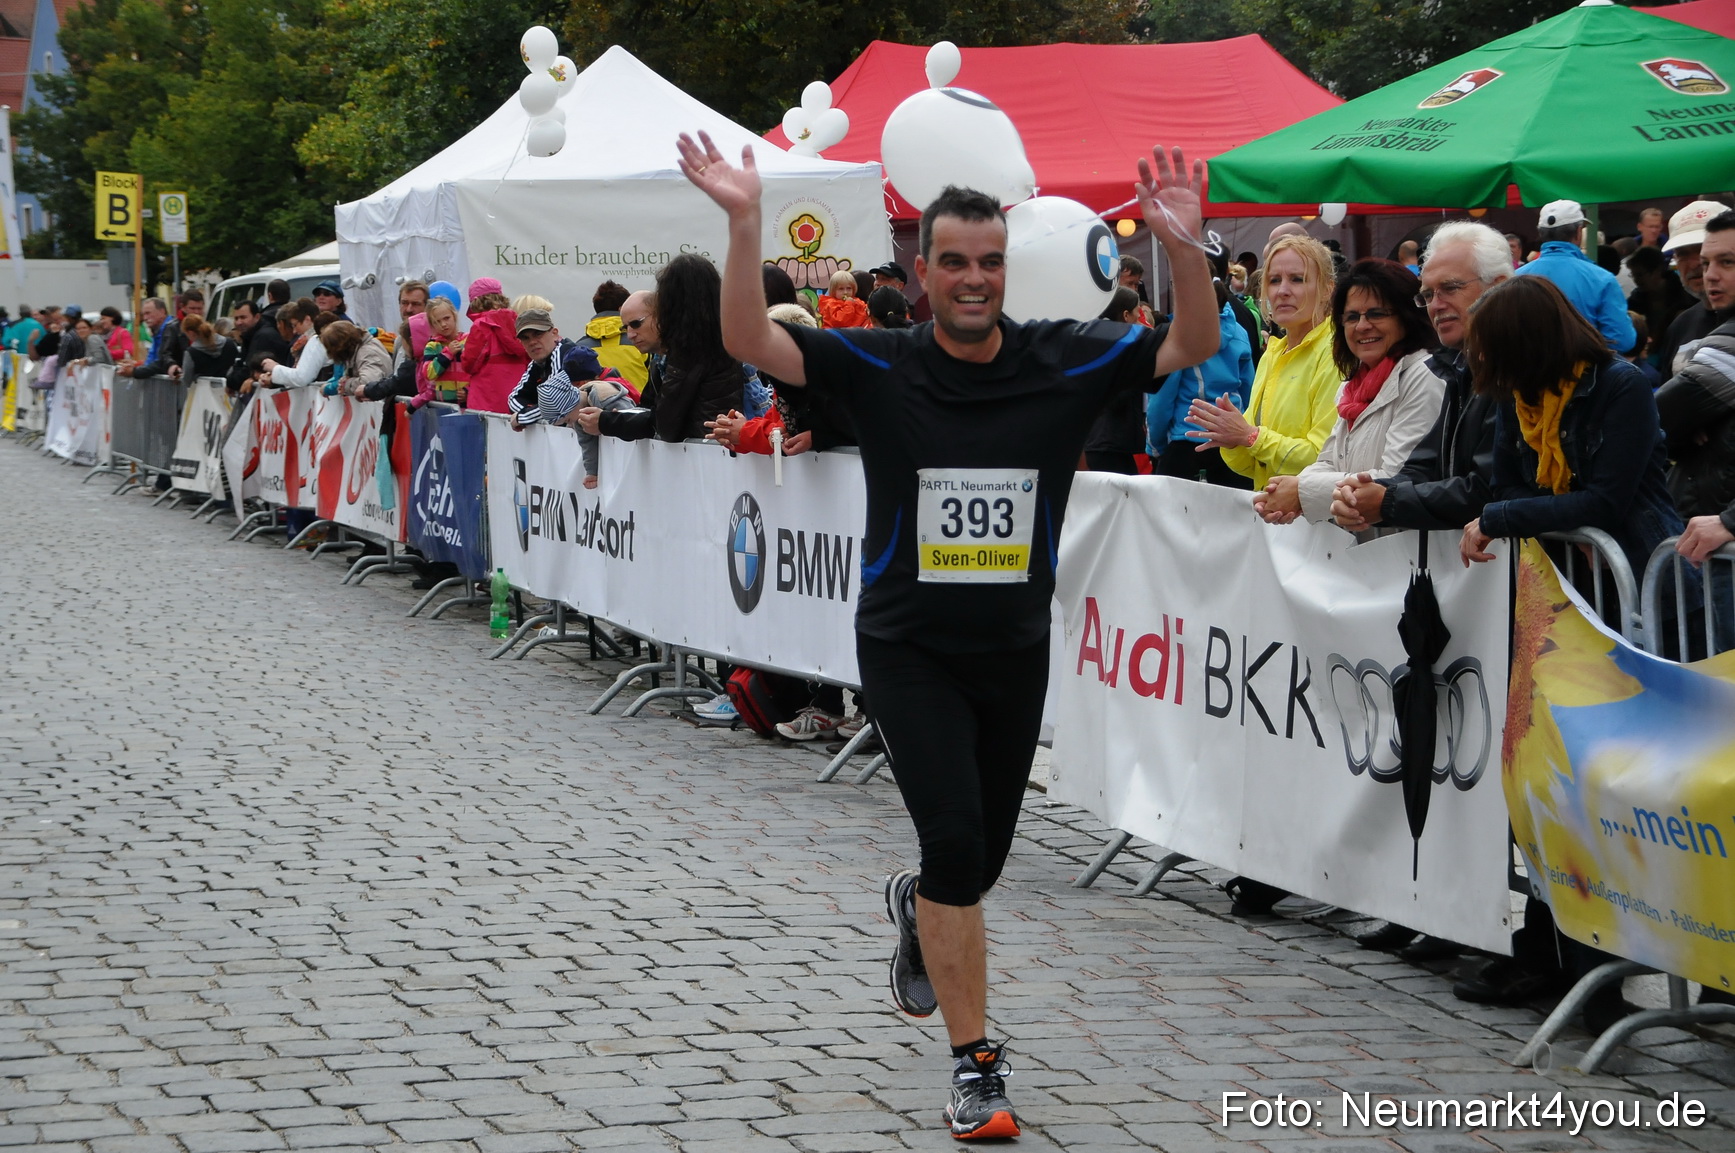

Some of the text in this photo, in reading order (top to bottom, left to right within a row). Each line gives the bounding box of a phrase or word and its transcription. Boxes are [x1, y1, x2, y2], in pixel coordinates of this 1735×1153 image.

[1356, 116, 1457, 133] Neumarkter
[1310, 131, 1448, 152] Lammsbräu
[102, 174, 138, 189] Block
[109, 193, 130, 226] B
[775, 201, 793, 223] KRANKEN
[793, 196, 806, 204] UND
[806, 196, 833, 214] EINSAMEN
[830, 213, 841, 238] KINDERN
[495, 245, 568, 266] Kinder
[574, 244, 671, 266] brauchen
[920, 480, 1018, 491] PARTL Neumarkt
[940, 497, 1014, 539] 393
[777, 527, 853, 603] BMW
[932, 549, 1020, 567] Sven-Oliver
[1076, 596, 1326, 750] Audi BKK
[1586, 875, 1662, 923] Außenplatten
